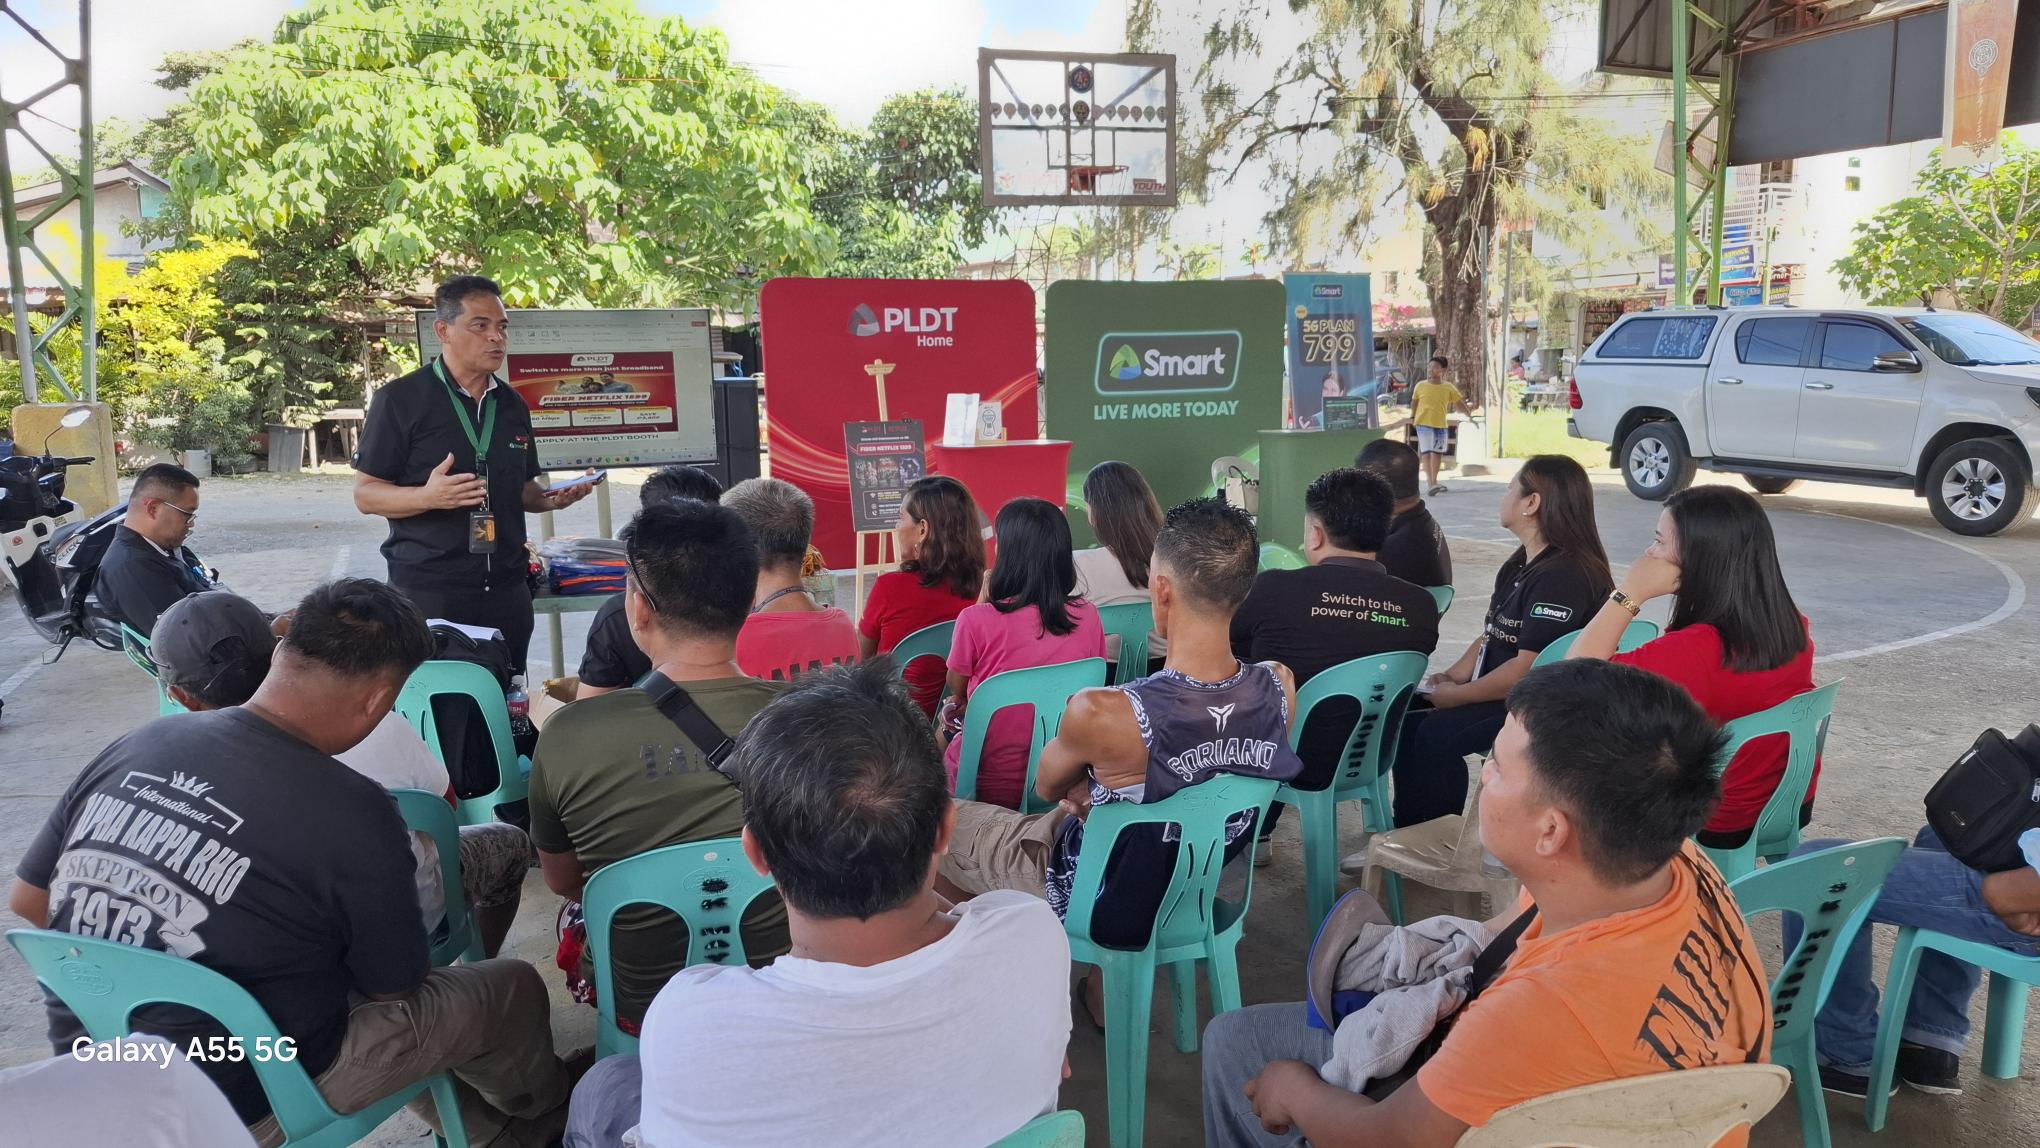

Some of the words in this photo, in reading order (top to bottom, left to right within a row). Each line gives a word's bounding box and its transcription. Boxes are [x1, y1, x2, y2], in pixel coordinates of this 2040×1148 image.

[1321, 287, 1341, 296] Smart
[884, 307, 958, 333] PLDT
[1303, 320, 1319, 333] 5G
[1320, 319, 1355, 333] PLAN
[917, 335, 953, 347] Home
[1302, 334, 1356, 363] 799
[1144, 347, 1225, 377] Smart
[1094, 405, 1128, 420] LIVE
[1132, 403, 1181, 419] MORE
[1186, 400, 1240, 417] TODAY
[536, 436, 566, 444] APPLY
[602, 434, 624, 442] PLDT
[626, 433, 659, 441] BOOTH
[1321, 592, 1366, 607] Switch
[1368, 598, 1381, 609] to
[1383, 601, 1402, 613] the
[1542, 607, 1567, 619] Smart
[1311, 606, 1353, 618] power
[1356, 610, 1369, 620] of
[1371, 611, 1410, 627] Smart.
[1167, 738, 1278, 782] SORIANO
[134, 785, 213, 824] International
[119, 808, 202, 874] KAPPA
[183, 838, 251, 905] RHO
[66, 855, 193, 923] SKEPTRON
[69, 886, 152, 947] 1973
